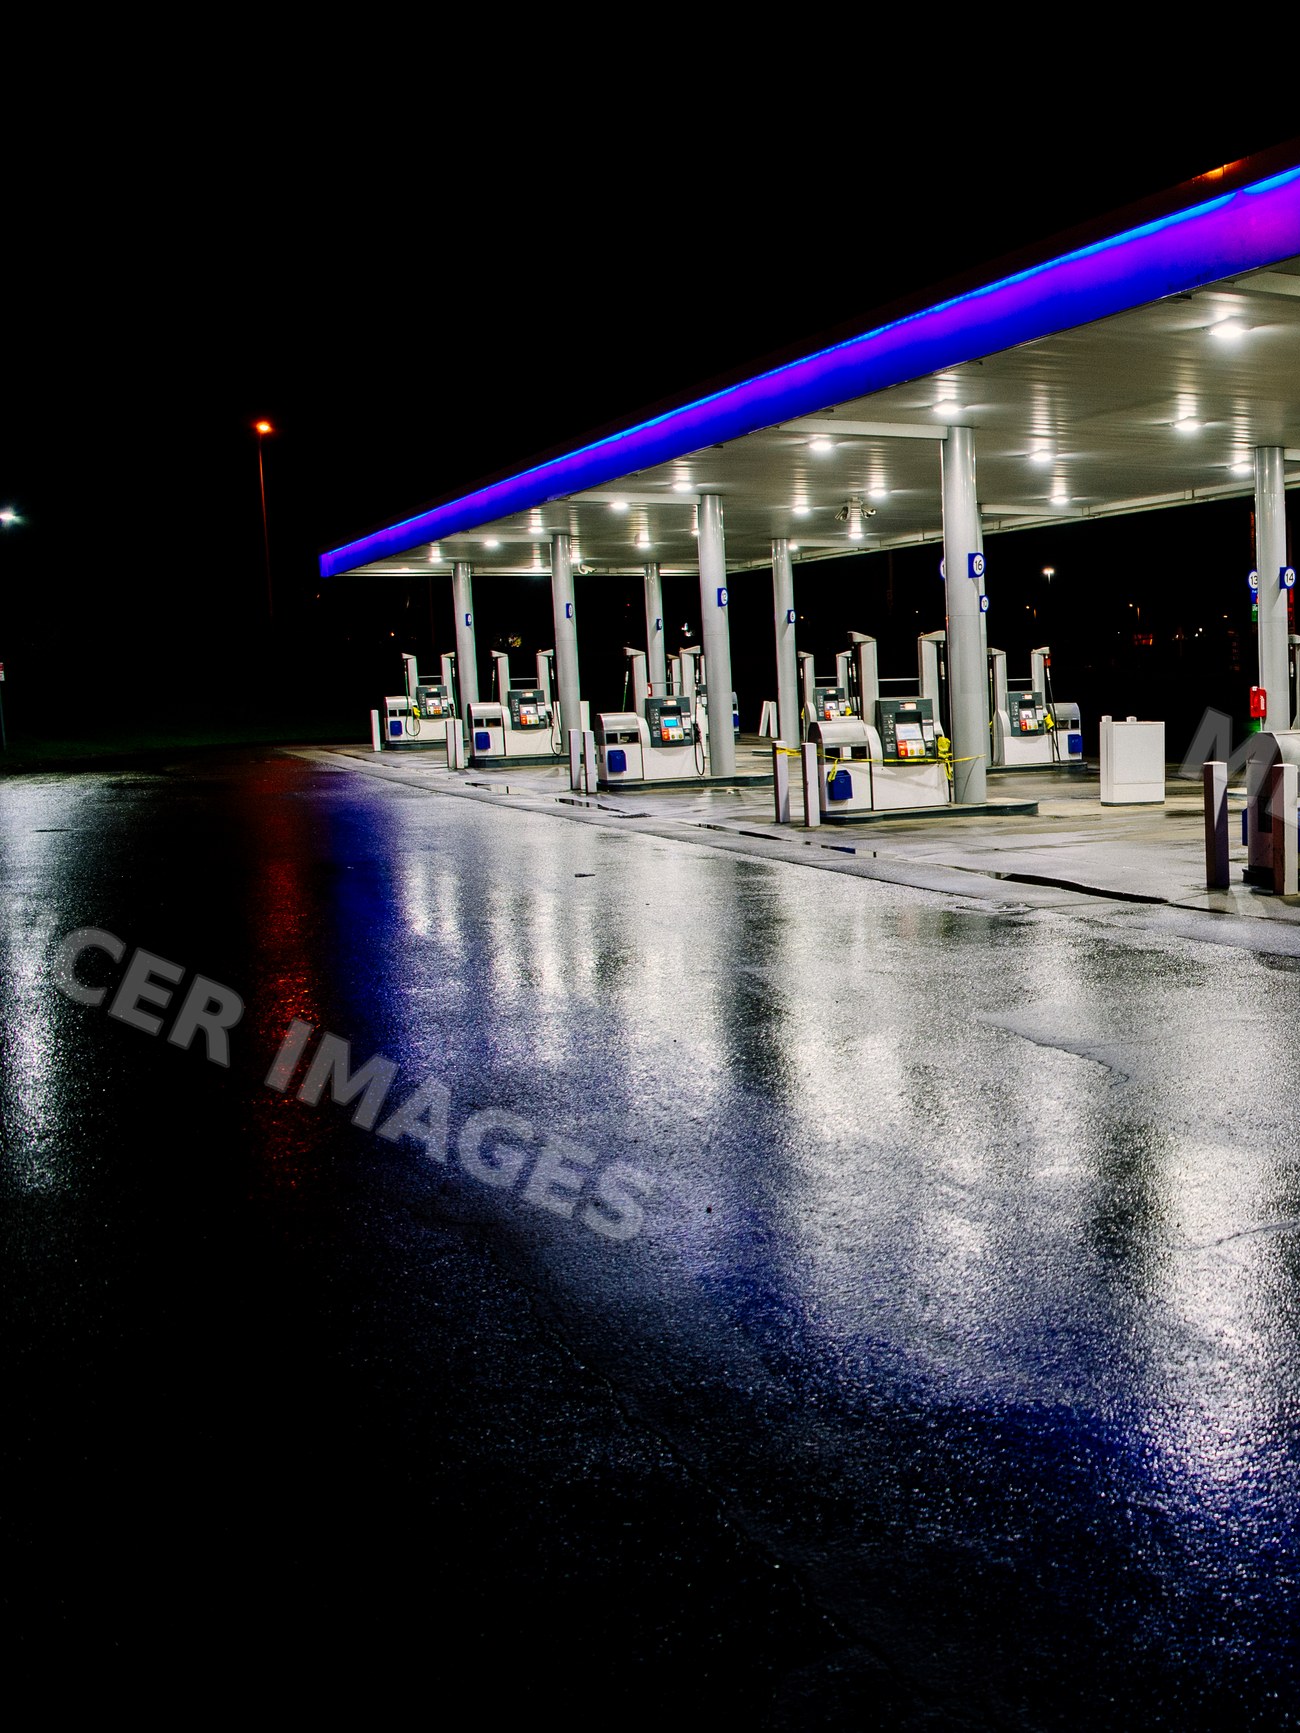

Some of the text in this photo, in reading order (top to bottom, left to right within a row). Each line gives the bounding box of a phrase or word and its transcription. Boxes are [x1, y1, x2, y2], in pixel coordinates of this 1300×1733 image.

[975, 559, 983, 571] 16
[1250, 575, 1258, 586] 13
[1285, 573, 1294, 583] 14
